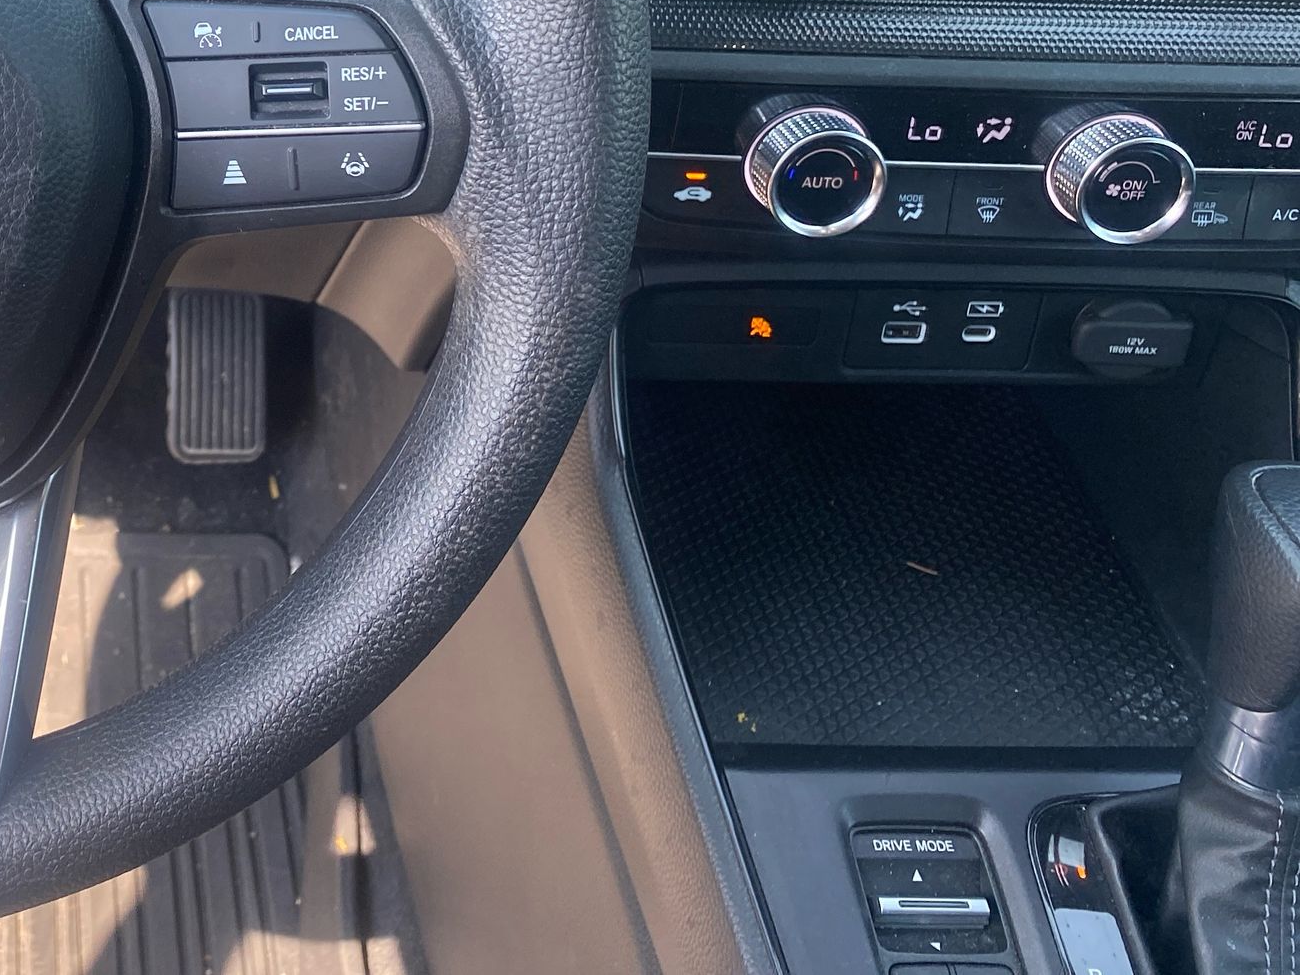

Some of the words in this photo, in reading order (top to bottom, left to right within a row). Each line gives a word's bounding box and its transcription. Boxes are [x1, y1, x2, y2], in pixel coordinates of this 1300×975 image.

[285, 25, 338, 41] CANCEL
[341, 66, 387, 82] RES/+
[1237, 120, 1257, 131] A/C
[1236, 130, 1253, 141] ON
[801, 176, 843, 190] AUTO
[1122, 179, 1148, 192] ON/
[899, 194, 925, 203] MODE
[1120, 190, 1145, 201] OFF
[976, 197, 1004, 206] FRONT
[1193, 201, 1217, 210] REAR
[1272, 208, 1300, 221] A/C
[1127, 337, 1146, 346] 12V
[1134, 346, 1158, 355] MAX
[872, 839, 912, 852] DRIVE
[916, 840, 955, 853] MODE
